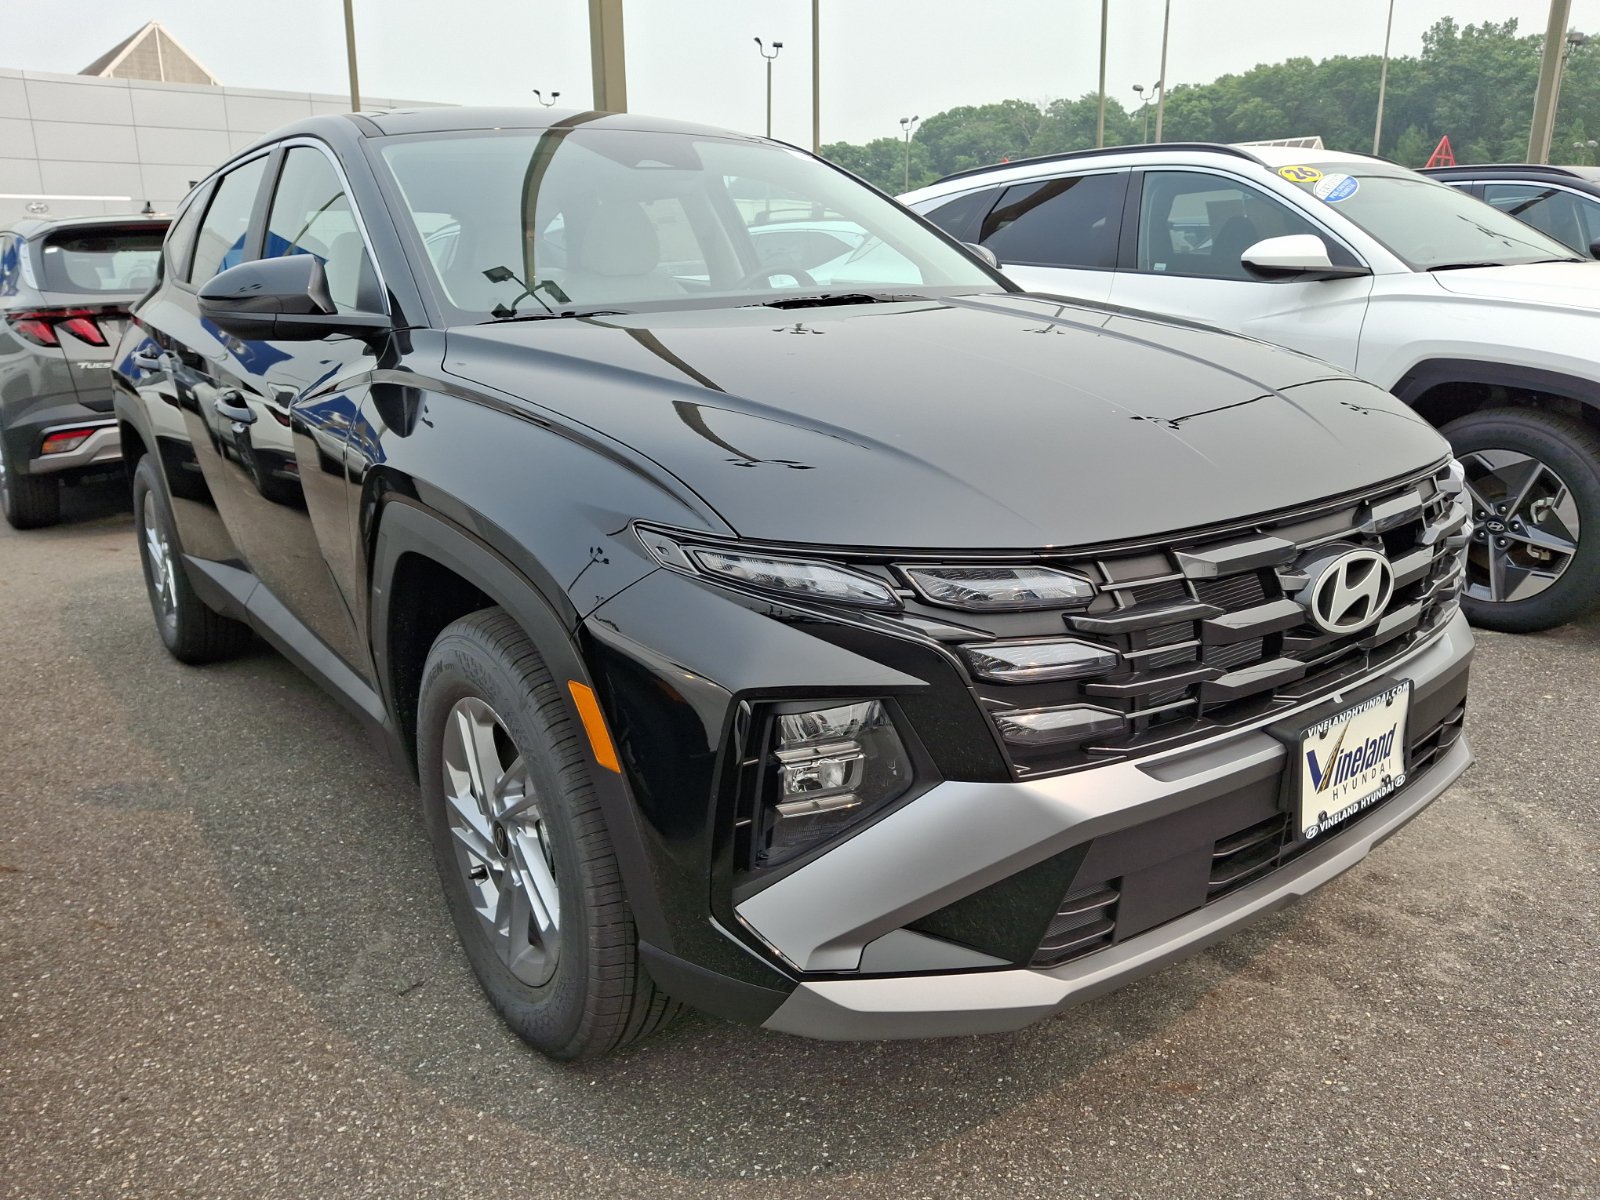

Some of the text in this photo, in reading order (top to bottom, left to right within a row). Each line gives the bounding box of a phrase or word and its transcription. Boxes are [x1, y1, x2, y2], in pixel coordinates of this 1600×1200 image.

[1284, 167, 1317, 180] 26
[76, 362, 112, 370] TUCS
[1307, 682, 1410, 738] VINELANDHYUNDAI.COM
[1306, 719, 1398, 795] Vineland
[1332, 760, 1392, 801] HYUNDAI
[1319, 782, 1395, 832] VINELAND HYUNDAI
